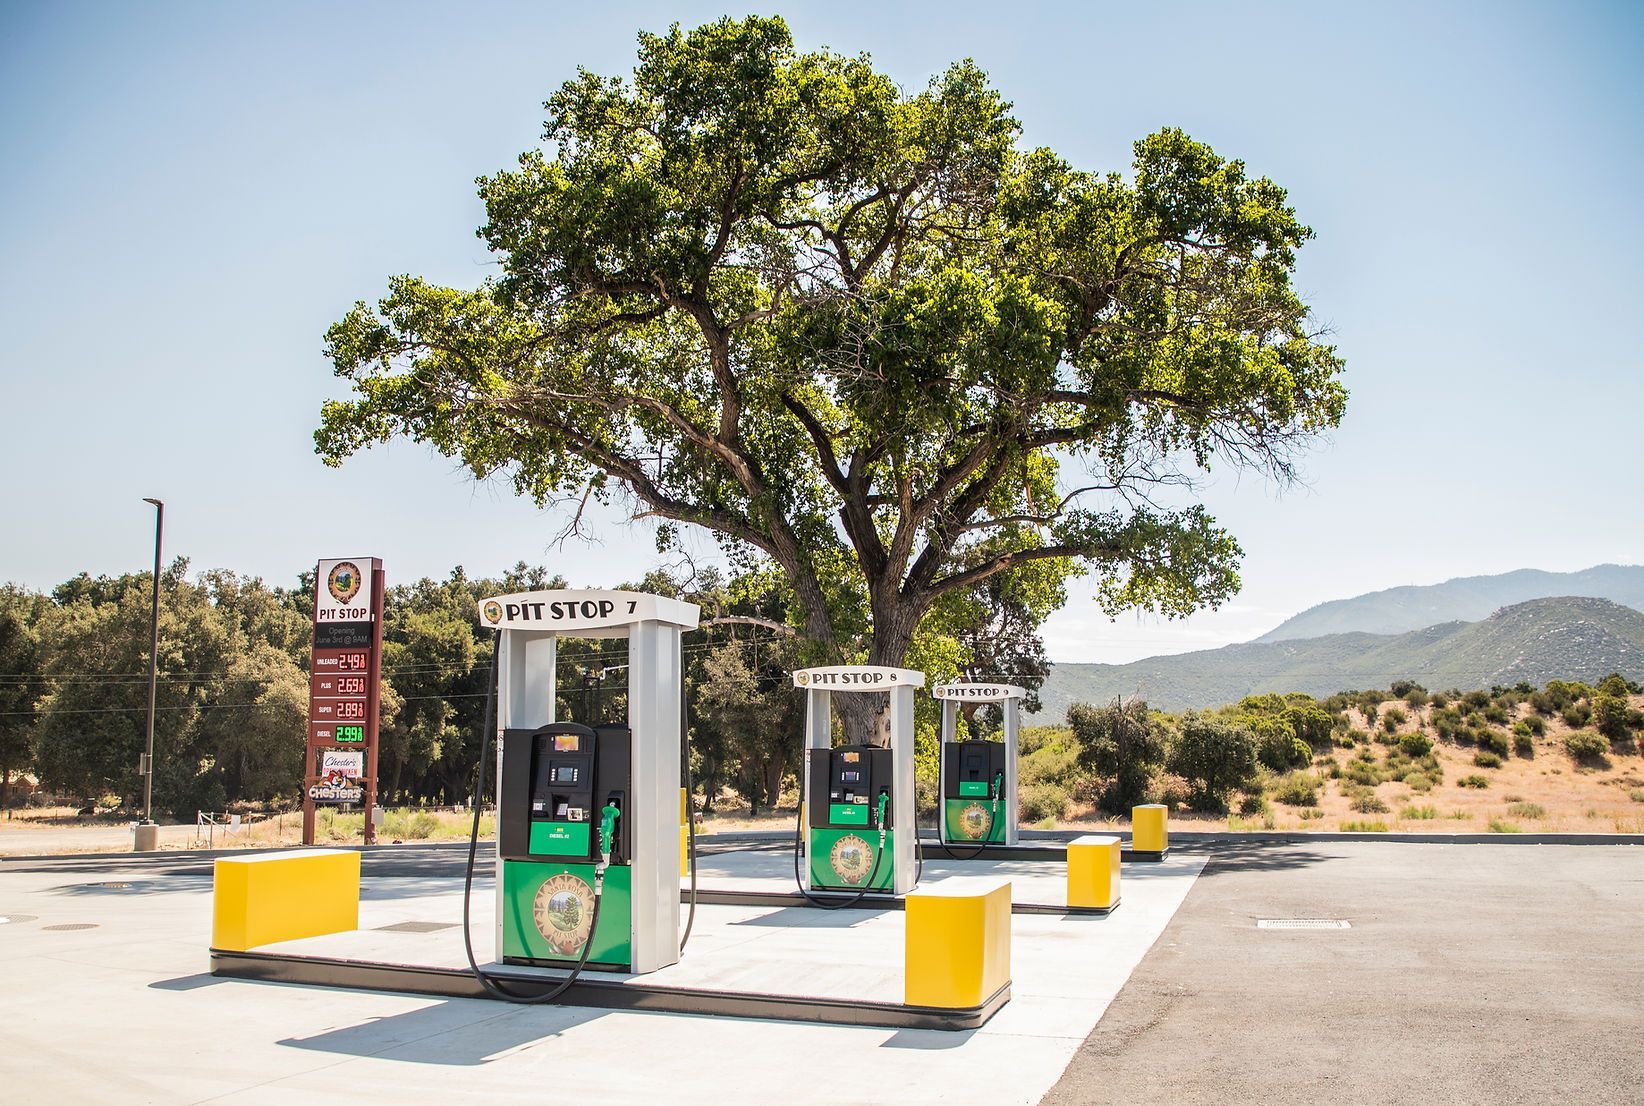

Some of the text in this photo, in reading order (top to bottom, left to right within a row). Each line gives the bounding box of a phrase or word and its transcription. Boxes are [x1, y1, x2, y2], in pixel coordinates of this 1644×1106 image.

[320, 608, 367, 619] PIT STOP
[506, 600, 637, 621] PIT STOP 7
[329, 627, 355, 635] Opening
[344, 635, 352, 645] @
[812, 672, 897, 684] PIT STOP 8
[947, 688, 966, 696] PIT
[968, 688, 999, 696] STOP
